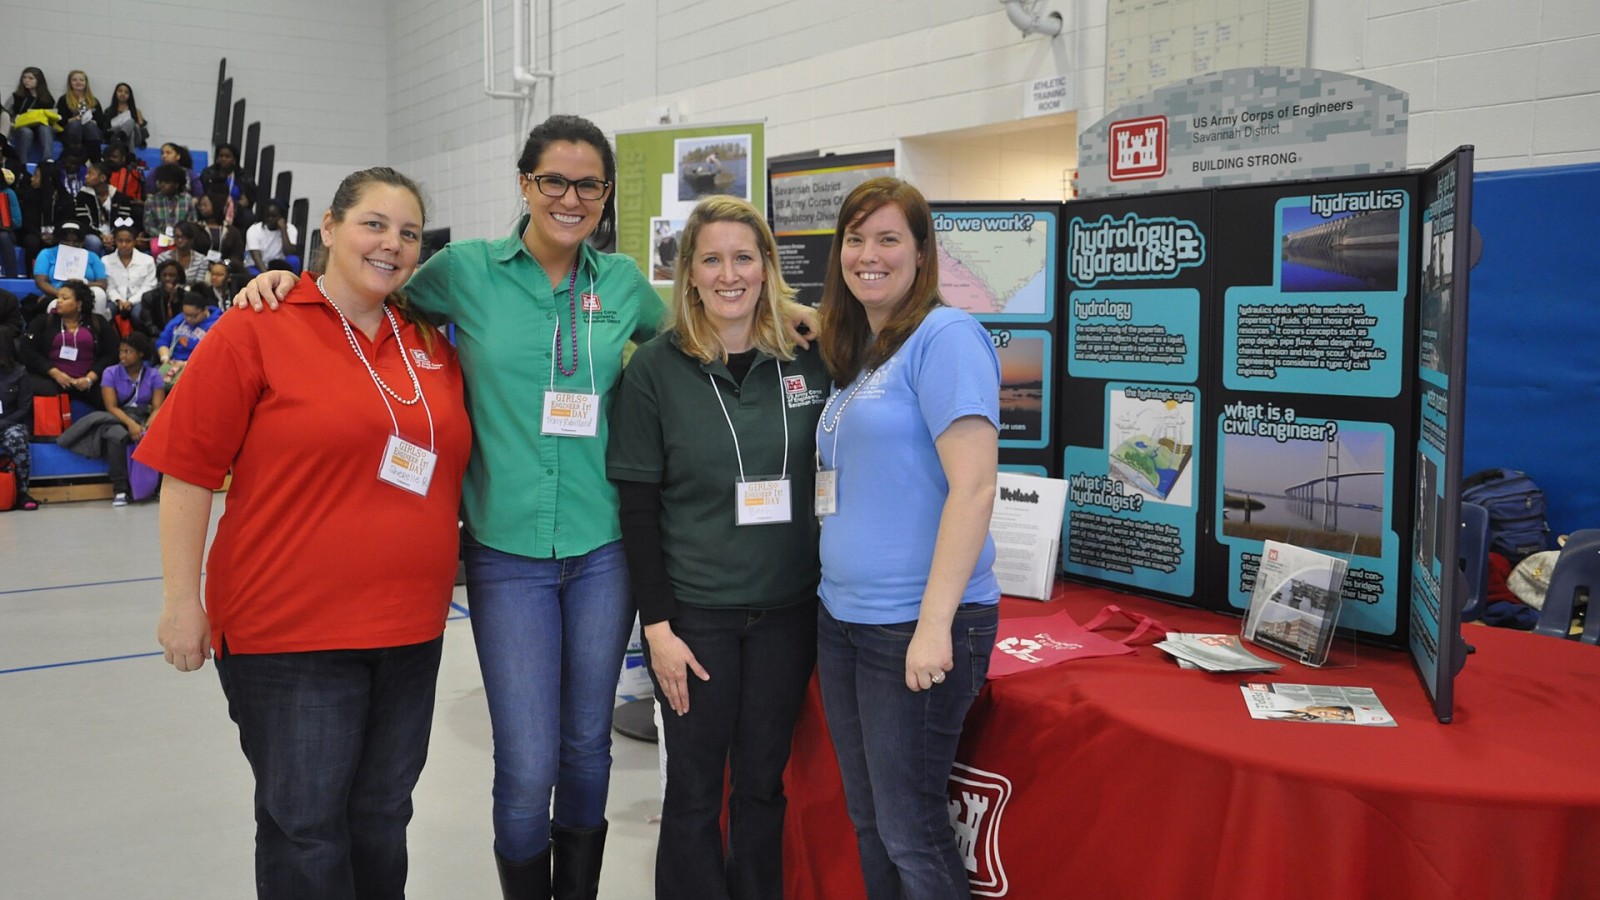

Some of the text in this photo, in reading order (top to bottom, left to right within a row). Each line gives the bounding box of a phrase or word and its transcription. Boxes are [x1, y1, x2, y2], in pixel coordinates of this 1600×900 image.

[1033, 76, 1066, 91] ATHLETIC
[1033, 88, 1066, 101] TRAINING
[1038, 100, 1060, 111] ROOM
[1193, 100, 1354, 129] US Army Corps of Engineers
[1193, 124, 1280, 144] Savannah District
[1192, 156, 1244, 172] BUILDING
[775, 182, 841, 197] Savannah District
[775, 195, 844, 211] US Army Corps Of
[1312, 190, 1402, 217] hydraulics
[775, 213, 814, 226] Regulatory
[934, 214, 1034, 231] do we work?
[1074, 219, 1175, 252] hydrology
[1072, 246, 1176, 280] hydraulics
[1074, 299, 1132, 320] hydrology
[1239, 305, 1364, 315] hydraulics deals with the mechanical
[1238, 316, 1271, 326] properties
[1272, 316, 1280, 326] of
[1302, 316, 1322, 326] often
[1323, 316, 1343, 325] those
[1344, 316, 1352, 327] of
[1354, 317, 1377, 325] water
[1305, 328, 1338, 337] concepts
[1339, 327, 1356, 336] such
[1238, 338, 1255, 347] pump
[1280, 338, 1294, 347] pipe
[1314, 338, 1329, 346] dam
[1356, 339, 1373, 347] river
[1264, 347, 1385, 360] erosion and bridge hydraulic
[1238, 358, 1369, 370] engineering is considered a type of civil
[1126, 388, 1194, 402] the hydrologic cycle
[1225, 401, 1295, 422] what is a
[1011, 423, 1026, 431] uses
[1224, 416, 1337, 442] civil engineer?
[399, 441, 422, 457] GIRLS
[749, 482, 773, 491] GIRLS
[1071, 474, 1123, 493] what is a
[1000, 486, 1040, 504] Wetlands
[1071, 488, 1143, 511] hydrologist?
[1350, 569, 1363, 579] and
[1358, 591, 1378, 603] large
